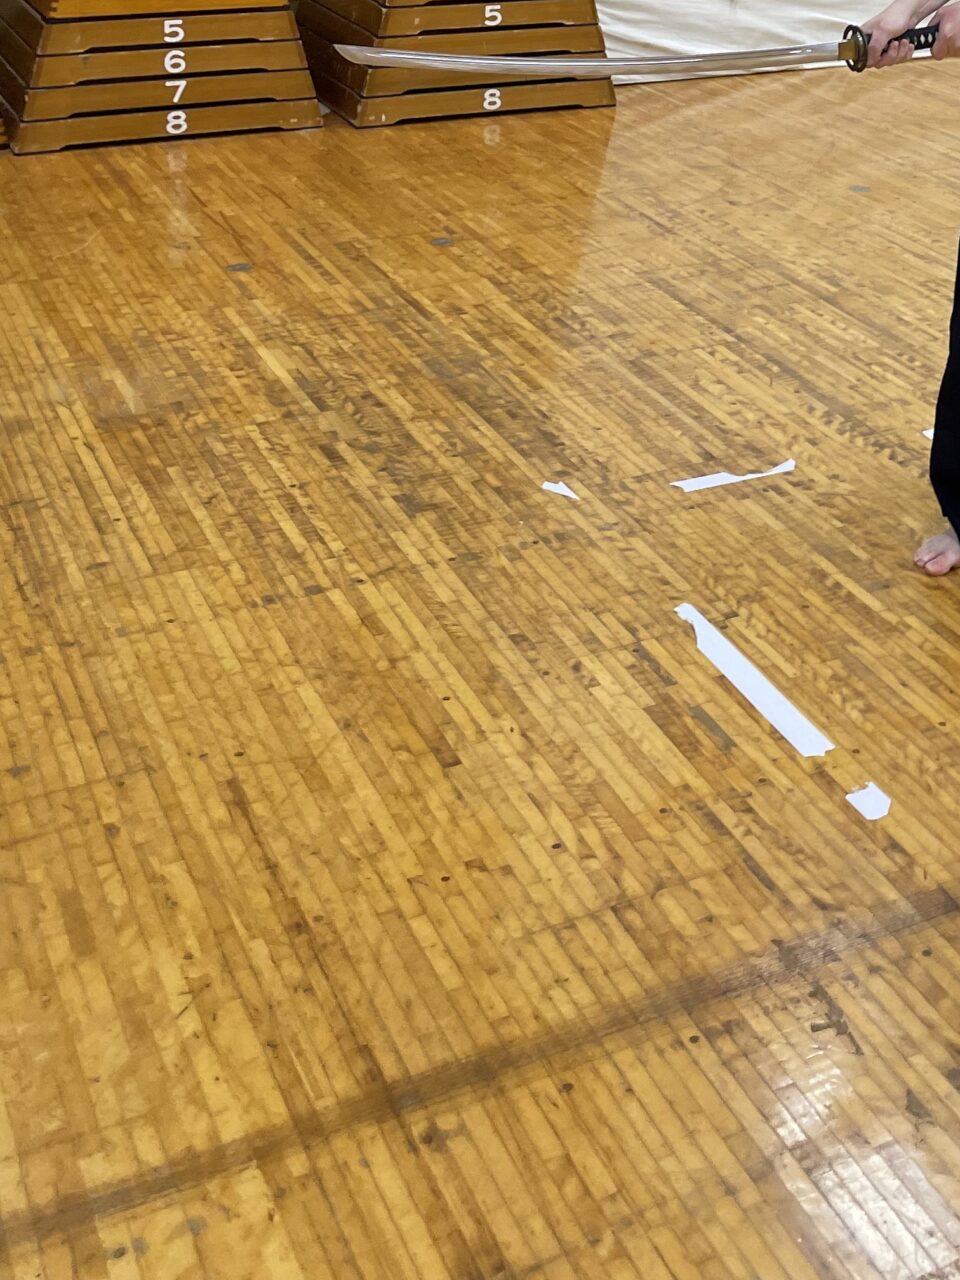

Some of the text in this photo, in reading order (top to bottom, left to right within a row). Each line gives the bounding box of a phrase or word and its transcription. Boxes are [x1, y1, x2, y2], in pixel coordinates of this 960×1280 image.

[484, 5, 502, 26] 5
[164, 20, 184, 42] 5
[164, 50, 186, 73] 6
[165, 80, 187, 103] 7
[483, 89, 502, 111] 8
[166, 110, 187, 134] 8
